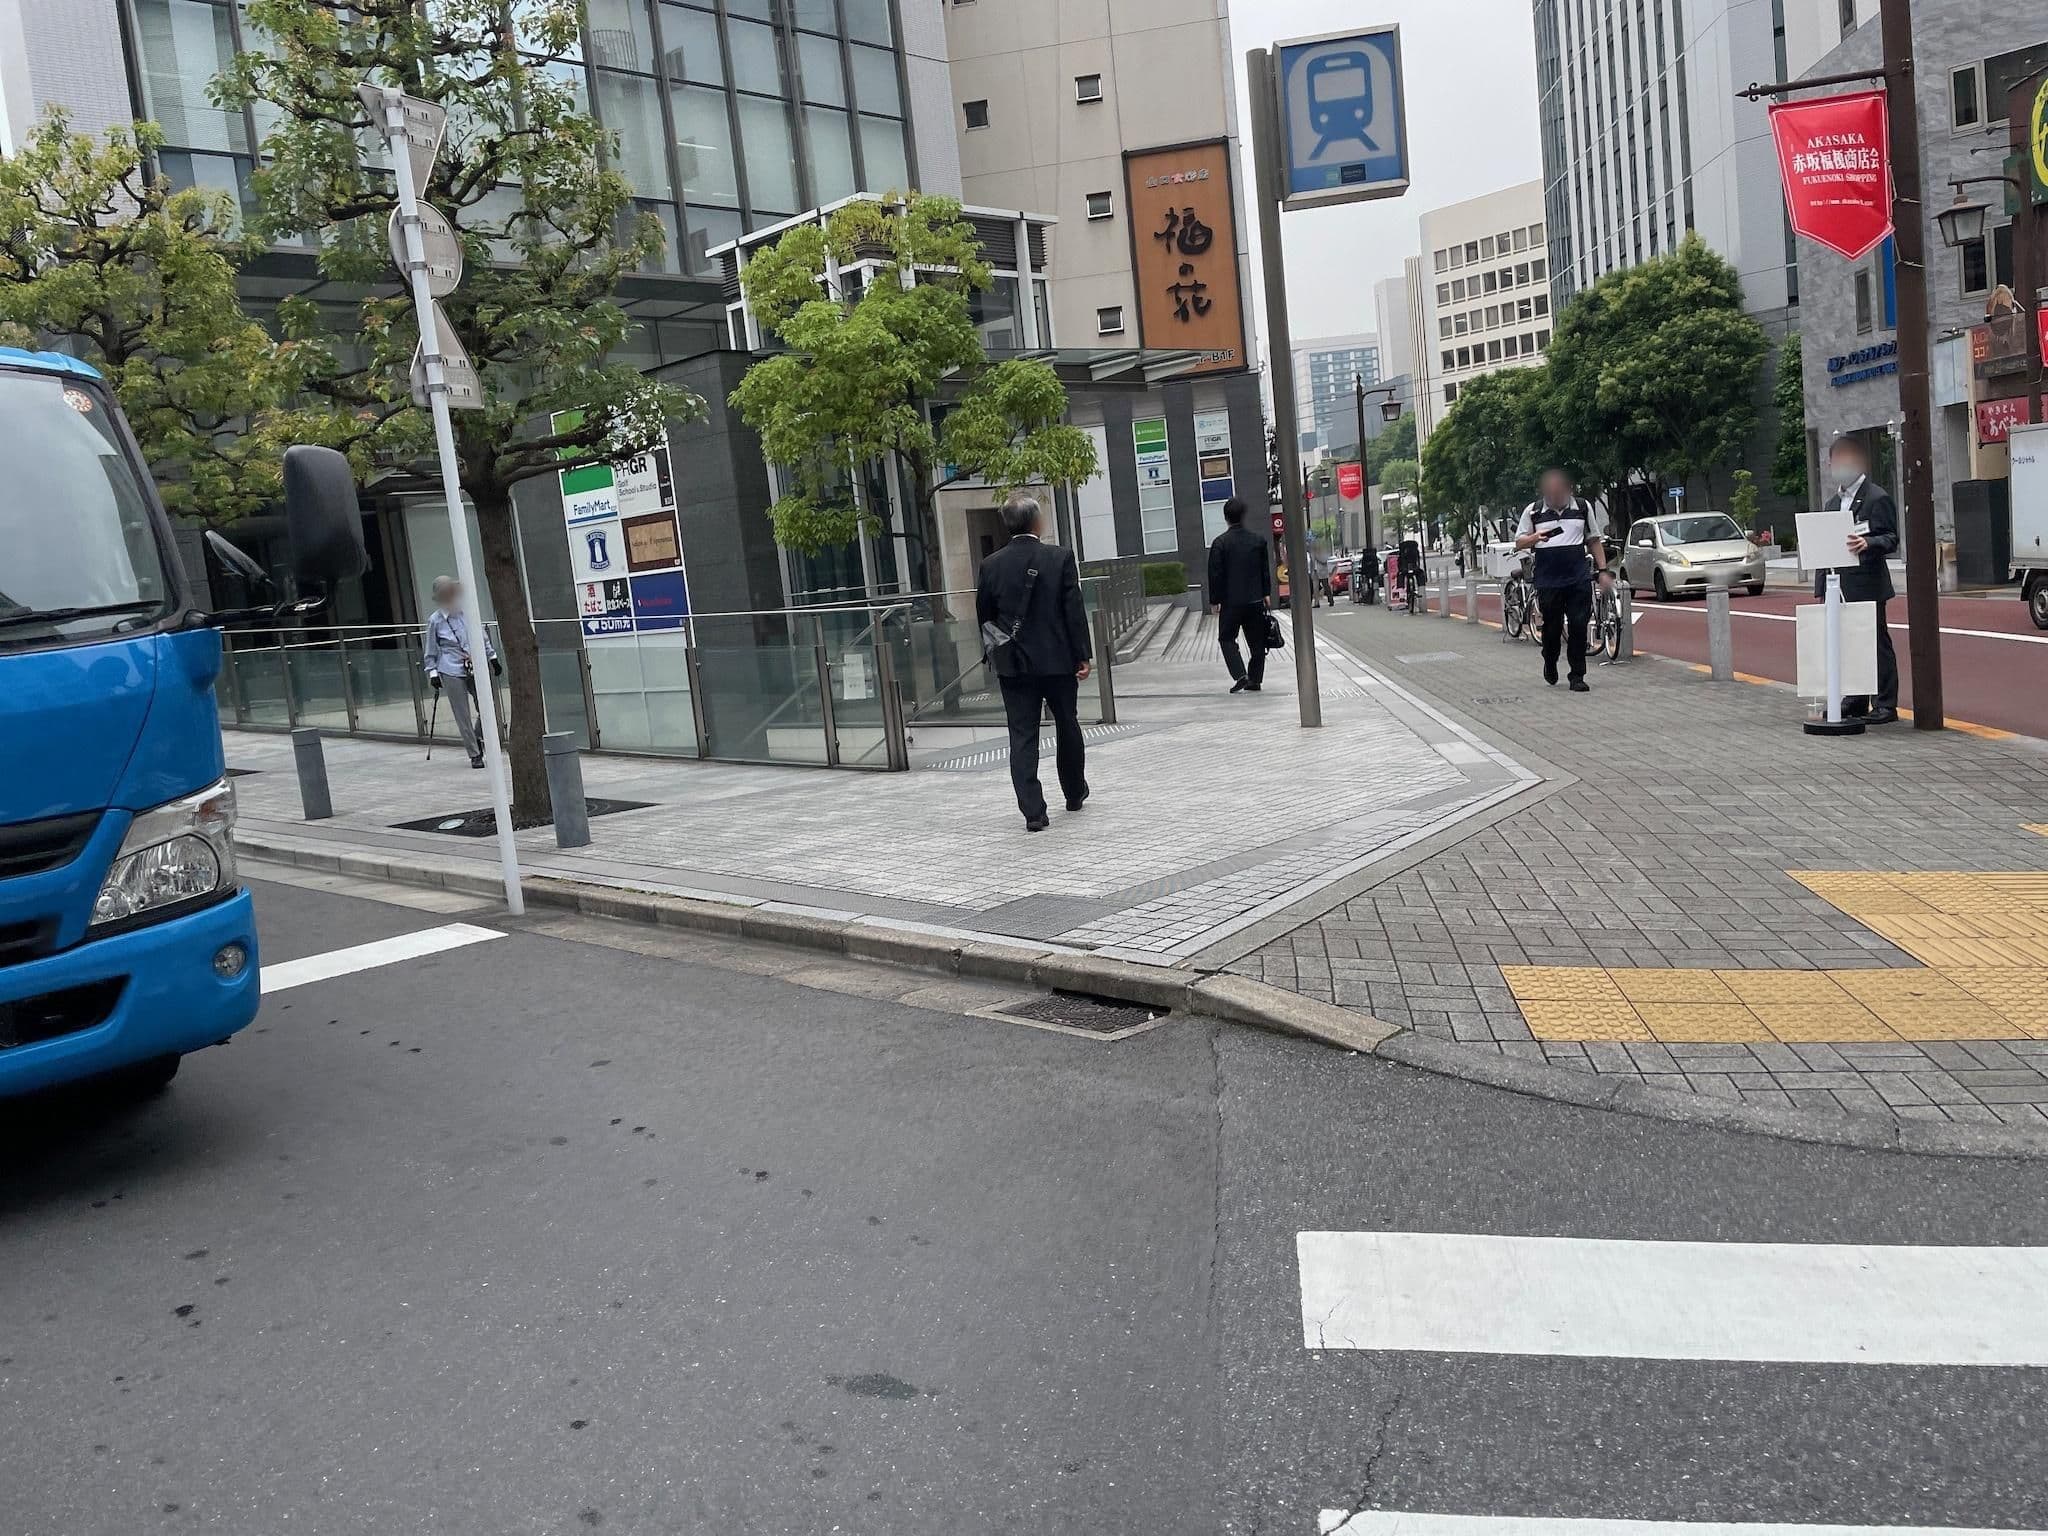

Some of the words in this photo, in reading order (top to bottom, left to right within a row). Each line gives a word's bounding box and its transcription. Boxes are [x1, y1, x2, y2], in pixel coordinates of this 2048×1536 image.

[1807, 133, 1865, 149] AKASAKA
[1846, 173, 1877, 183] SHOPPING
[1211, 350, 1235, 363] B1F
[618, 486, 637, 496] School
[640, 482, 657, 492] Studio
[573, 499, 611, 516] FamilyMart
[584, 600, 603, 613] たばこ
